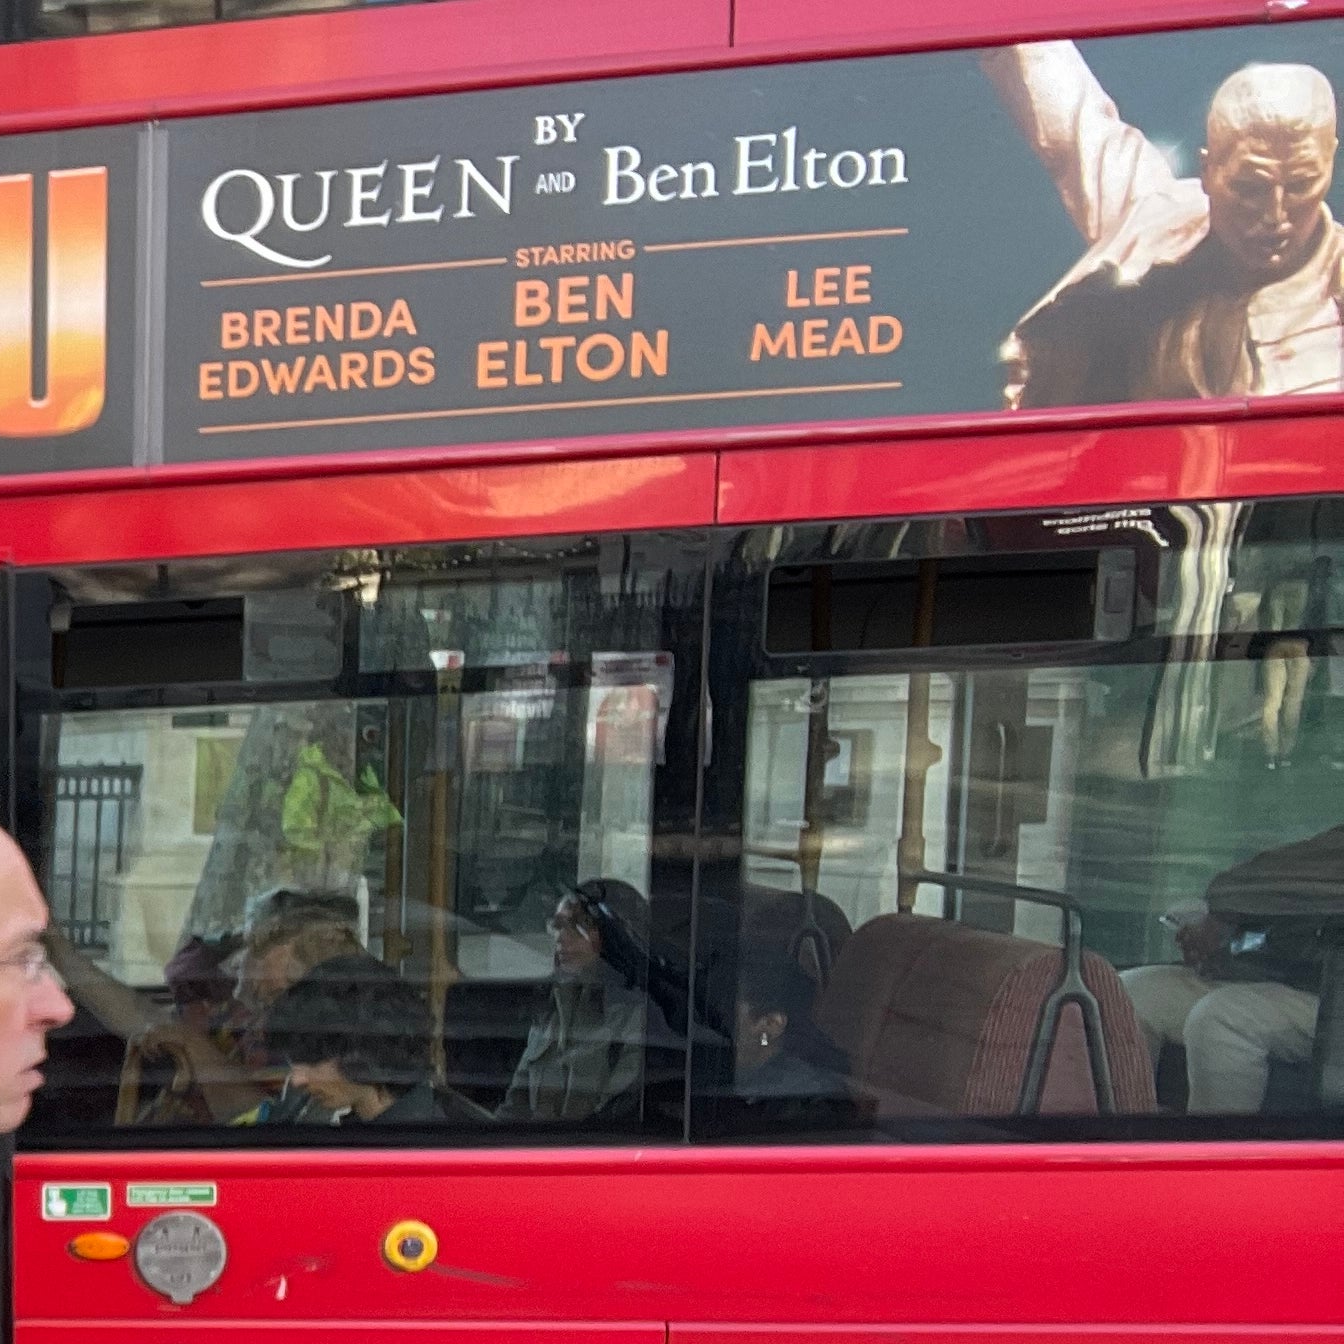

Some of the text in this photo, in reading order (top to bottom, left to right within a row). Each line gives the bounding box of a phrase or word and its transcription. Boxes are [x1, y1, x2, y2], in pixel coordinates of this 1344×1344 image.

[534, 112, 585, 146] BY
[200, 127, 909, 269] QUEEN AND Ben Elton
[515, 239, 636, 268] STARRING
[515, 272, 635, 328] BEN
[786, 265, 872, 309] LEE
[220, 298, 417, 351] BRENDA
[749, 315, 904, 363] MEAD
[197, 348, 436, 401] EDWARDS
[476, 330, 669, 390] ELTON
